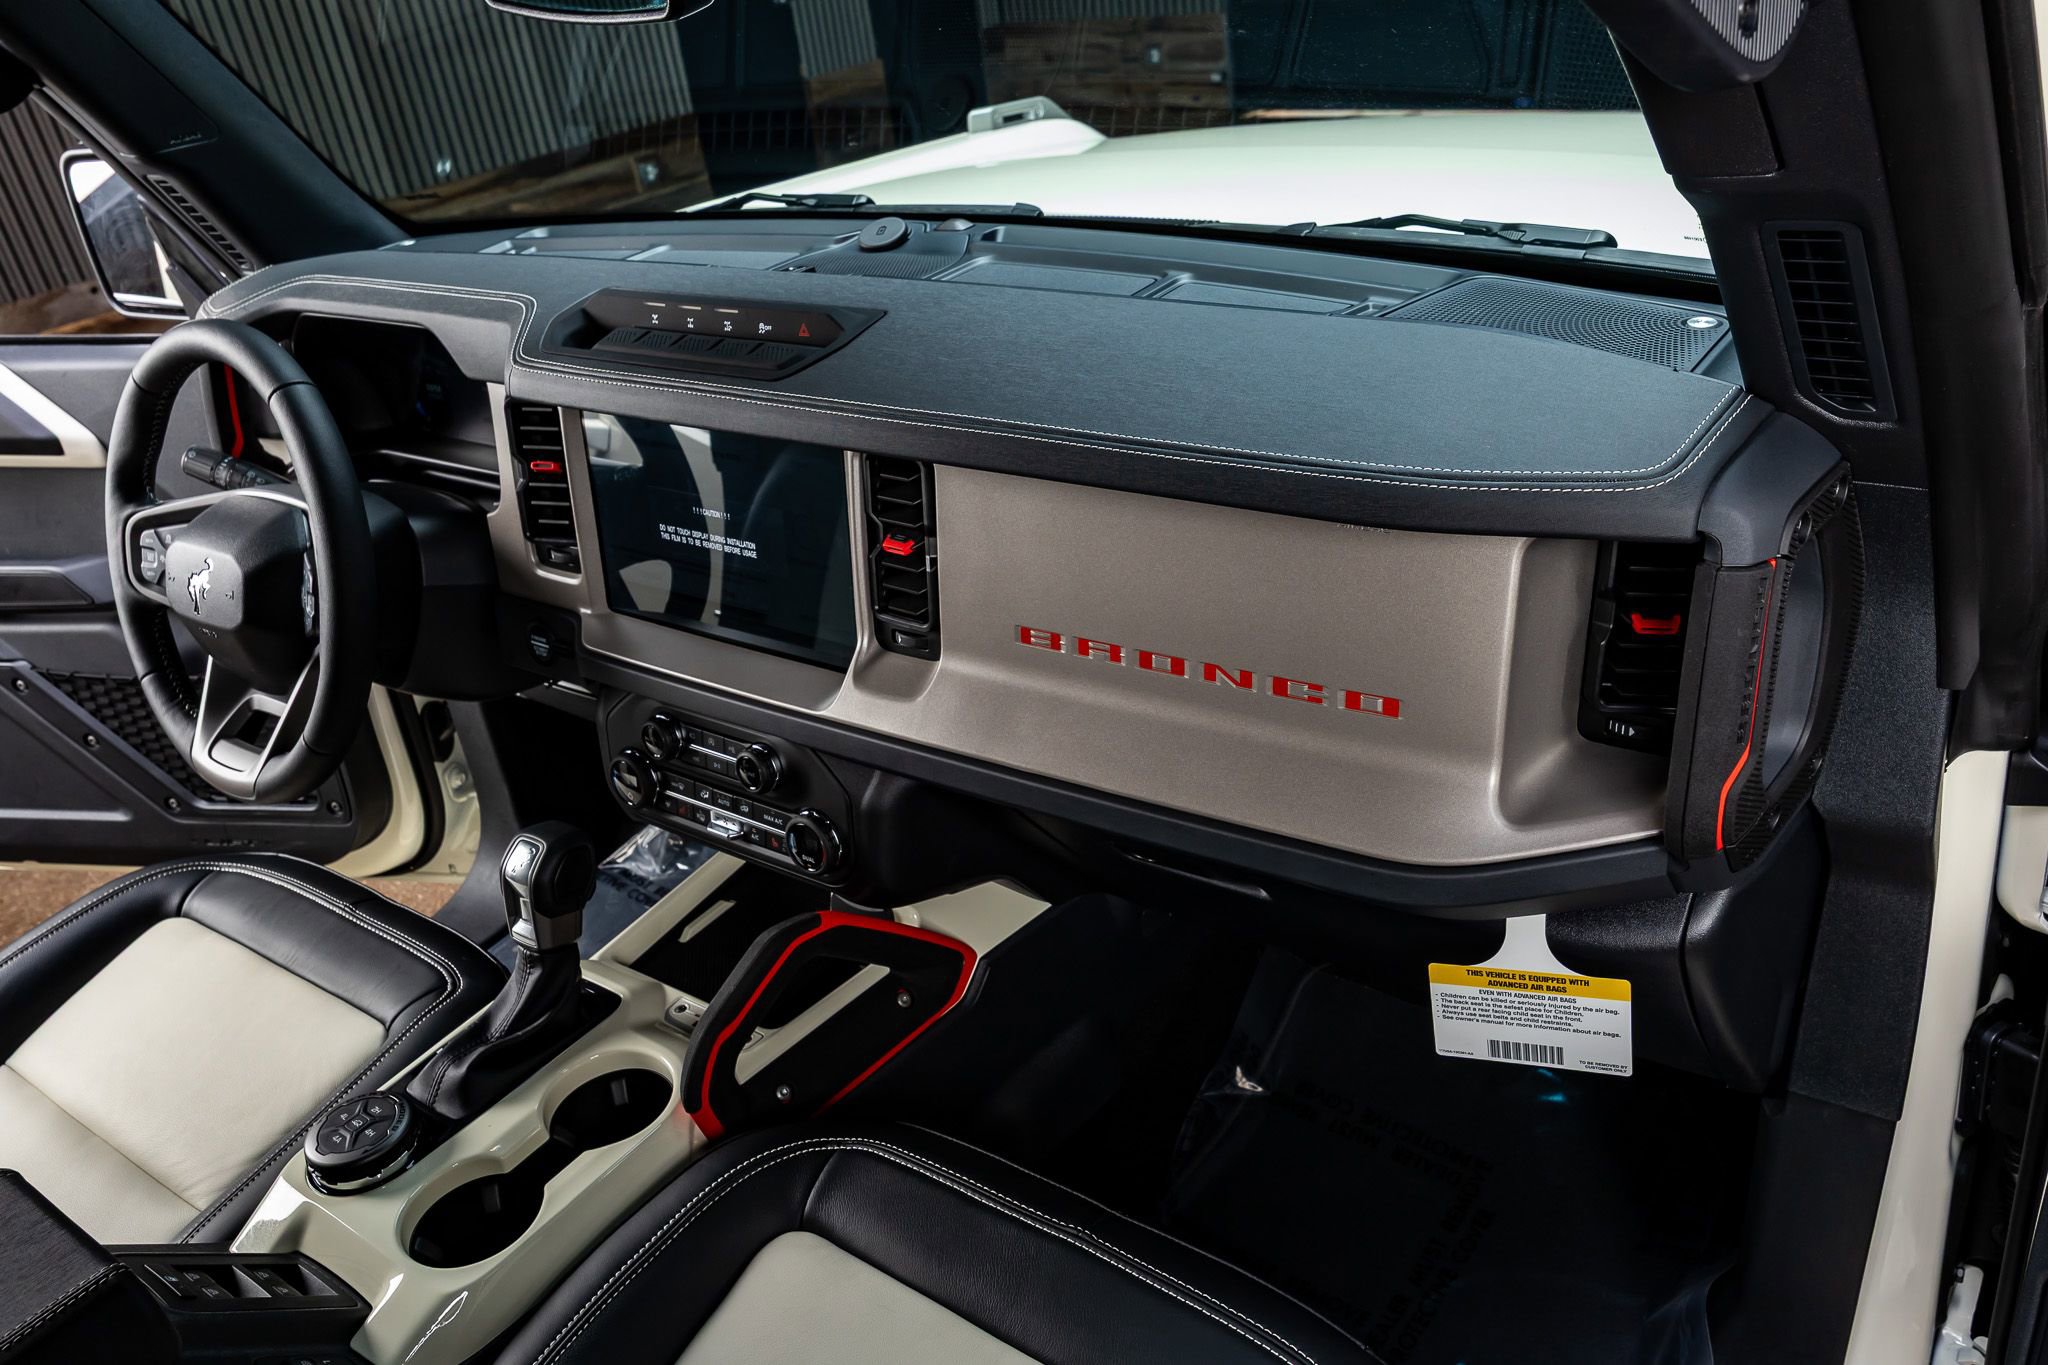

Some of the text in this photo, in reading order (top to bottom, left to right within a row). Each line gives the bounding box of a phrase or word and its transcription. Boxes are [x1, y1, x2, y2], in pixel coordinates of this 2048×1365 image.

[677, 527, 691, 536] TOUCH
[692, 530, 708, 539] DISPLAY
[710, 534, 726, 543] DURING
[727, 537, 756, 550] INSTALLATION
[660, 532, 670, 540] THIS
[671, 534, 681, 542] FILM
[702, 541, 722, 551] REMOVED
[724, 545, 741, 555] BEFORE
[742, 549, 757, 558] USAGE
[1015, 624, 1402, 720] BRONCO
[763, 814, 774, 822] MAX
[802, 854, 815, 863] DUAL
[1485, 971, 1516, 980] VEHICLE
[1529, 975, 1566, 984] EQUIPPED
[1488, 980, 1528, 989] ADVANCED
[1541, 1018, 1573, 1027] restraints.
[1534, 1024, 1570, 1032] information
[364, 1128, 376, 1137] 4H
[332, 1135, 342, 1144] 4A
